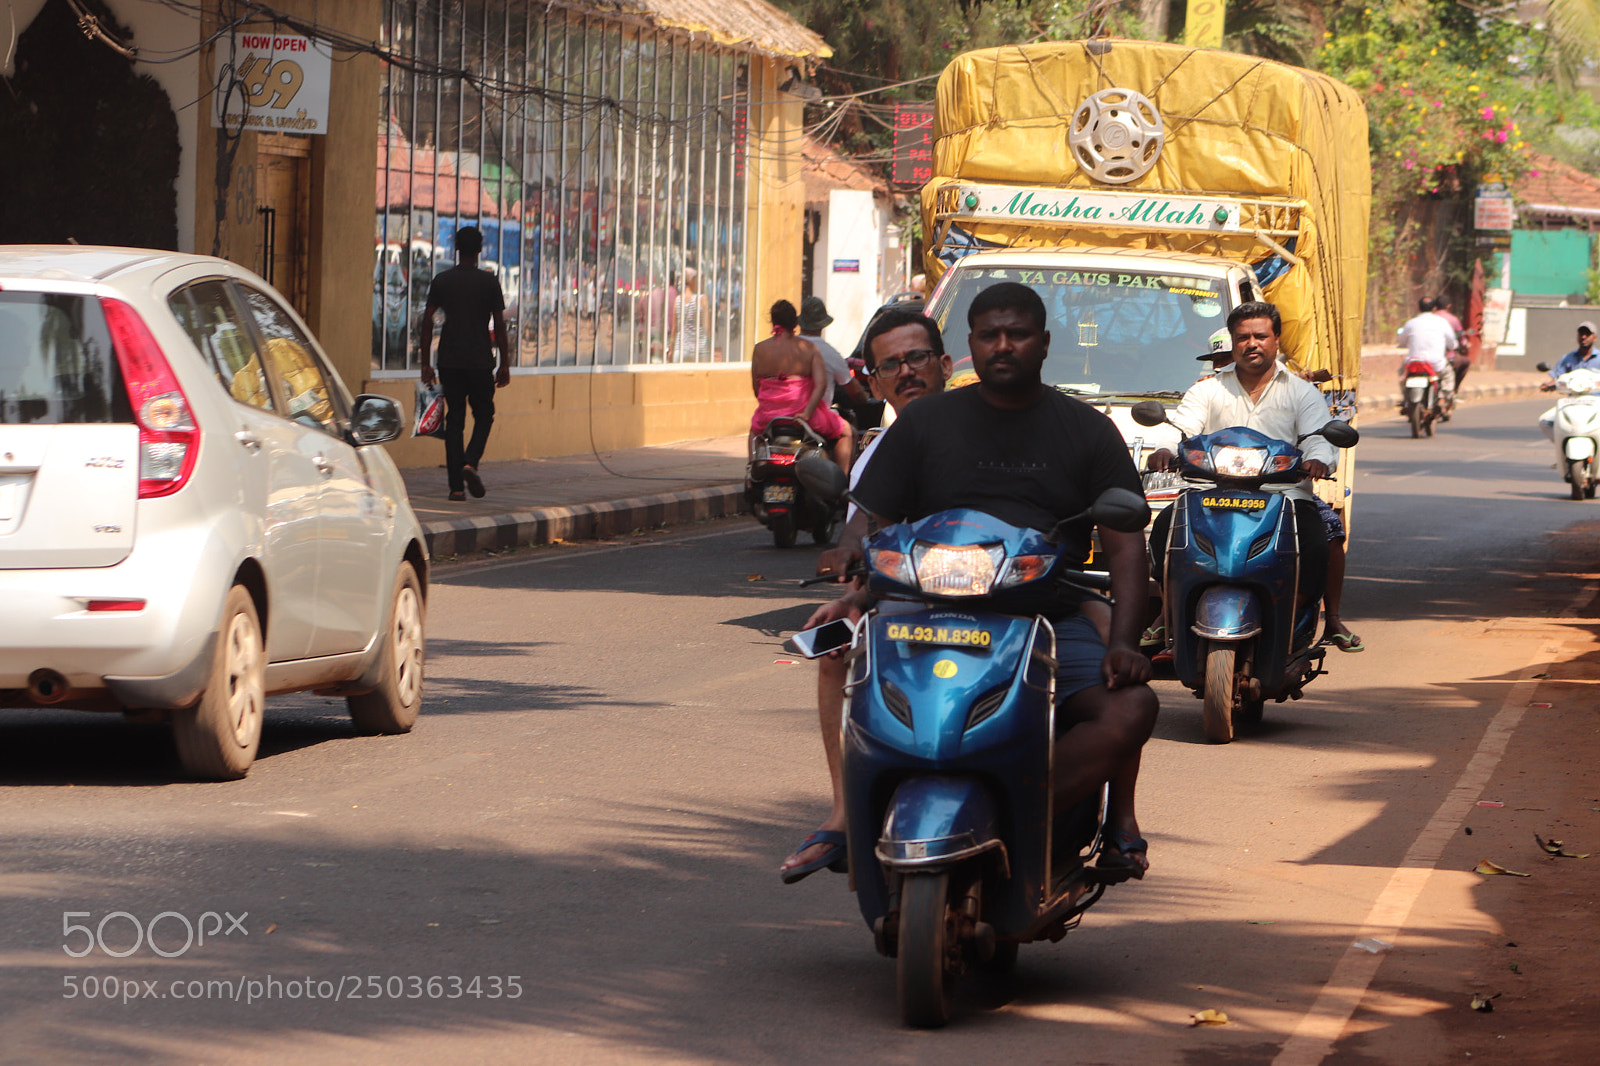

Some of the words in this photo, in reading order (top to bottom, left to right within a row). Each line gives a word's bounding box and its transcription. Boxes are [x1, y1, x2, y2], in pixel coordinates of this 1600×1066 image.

[242, 35, 271, 49] NOW
[273, 38, 307, 52] OPEN
[992, 191, 1103, 220] Masha
[1109, 199, 1206, 225] Allah
[1018, 271, 1047, 284] YA
[1052, 271, 1111, 287] GAUS
[1115, 274, 1163, 290] PAK
[929, 612, 978, 622] HONDA
